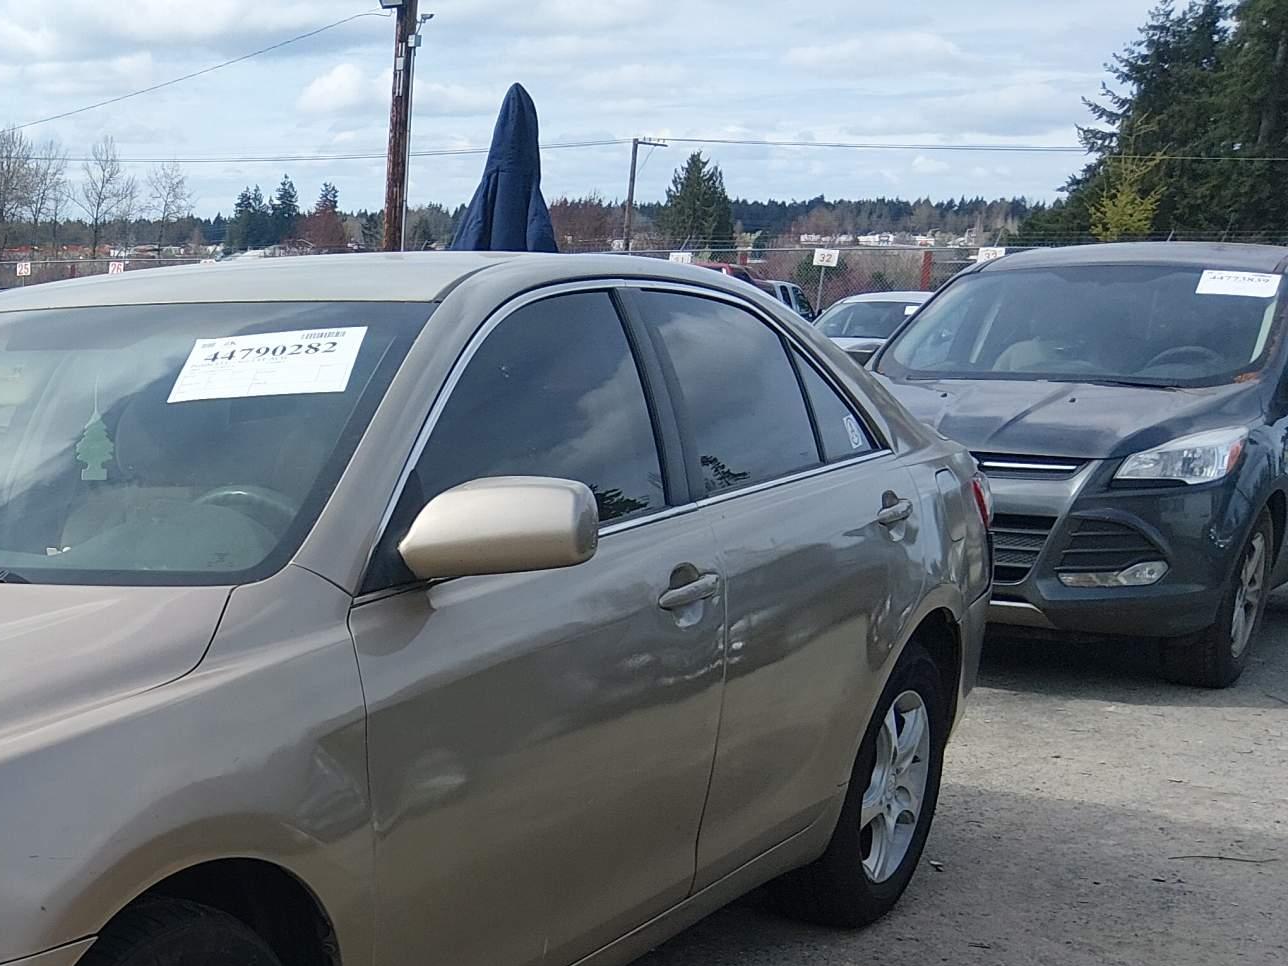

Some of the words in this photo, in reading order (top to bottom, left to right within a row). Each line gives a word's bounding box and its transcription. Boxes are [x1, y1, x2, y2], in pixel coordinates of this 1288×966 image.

[819, 253, 833, 263] 32
[18, 263, 29, 275] 25
[110, 263, 123, 274] 26
[203, 341, 338, 362] 44790282
